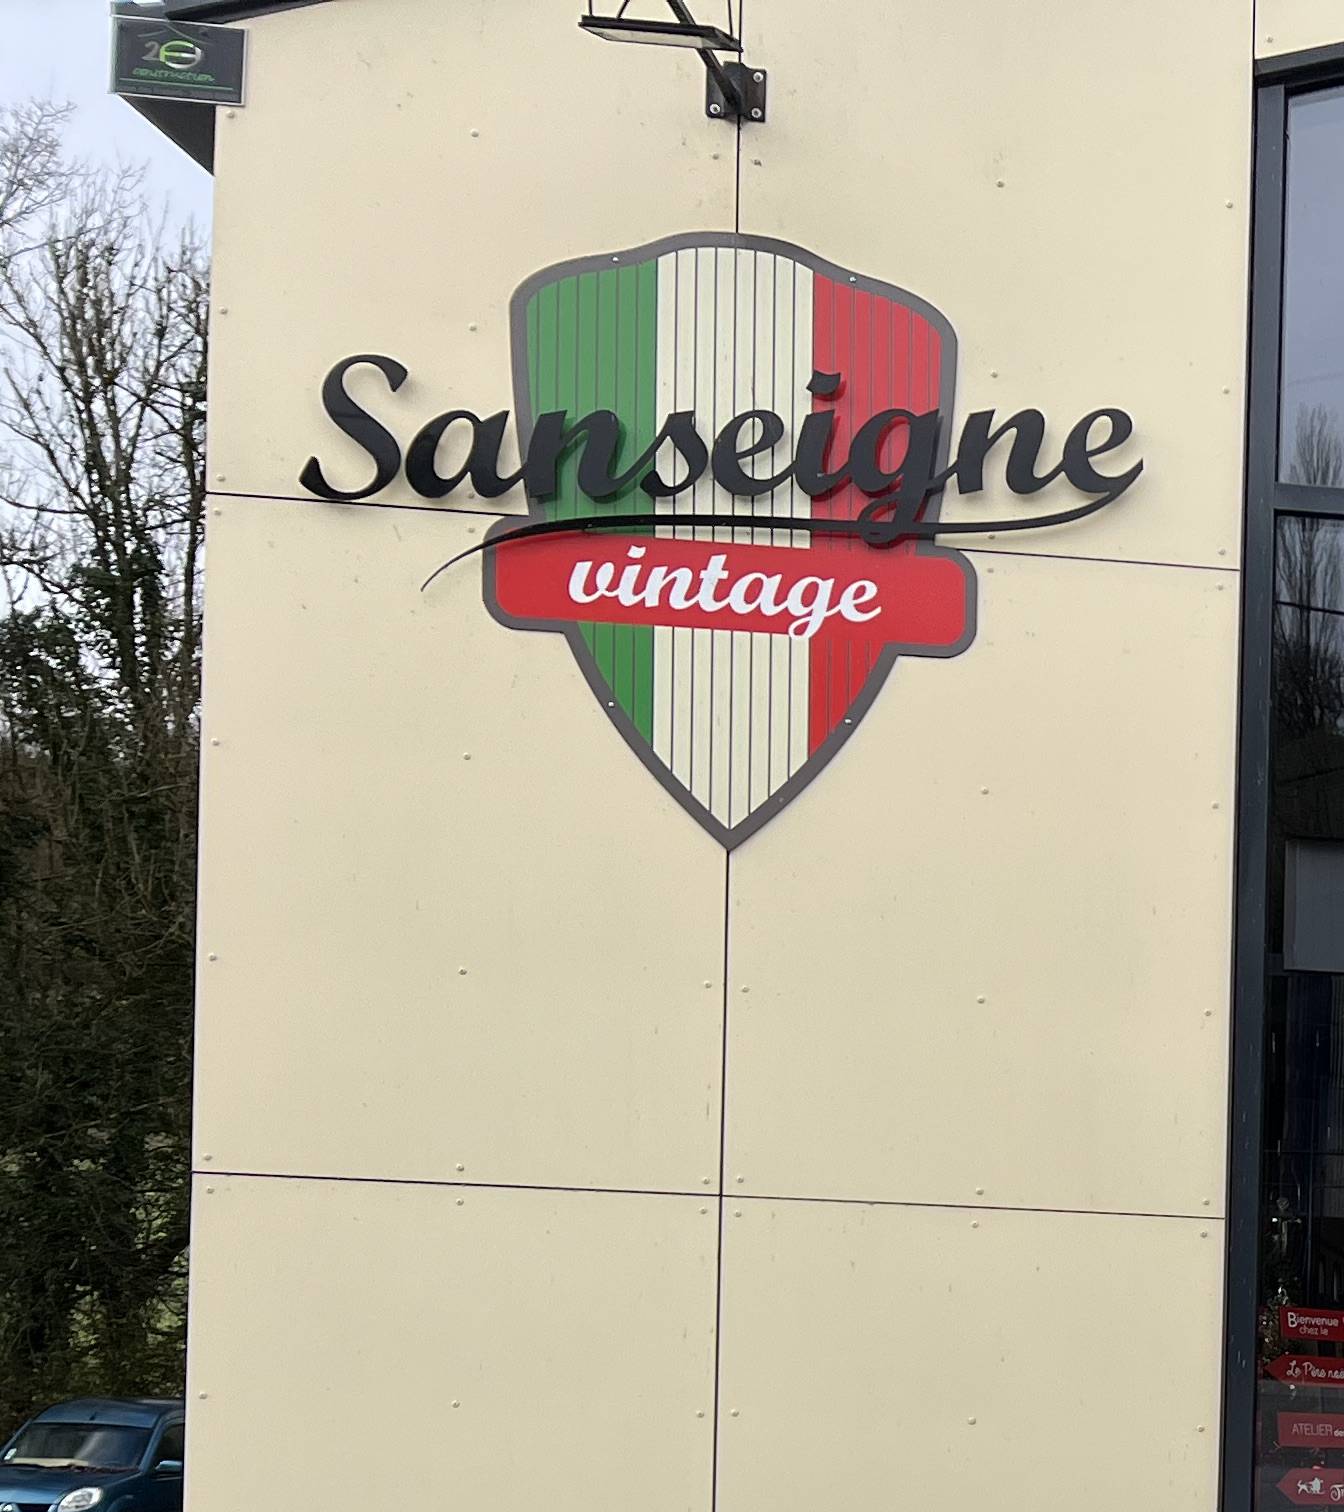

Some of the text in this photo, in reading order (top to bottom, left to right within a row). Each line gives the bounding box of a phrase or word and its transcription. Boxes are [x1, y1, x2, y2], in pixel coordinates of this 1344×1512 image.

[298, 353, 1144, 551] Sanseigne
[567, 545, 882, 638] vintage
[1286, 1311, 1340, 1328] Bienvenue
[1298, 1324, 1319, 1336] chez
[1291, 1423, 1333, 1437] ATELIER
